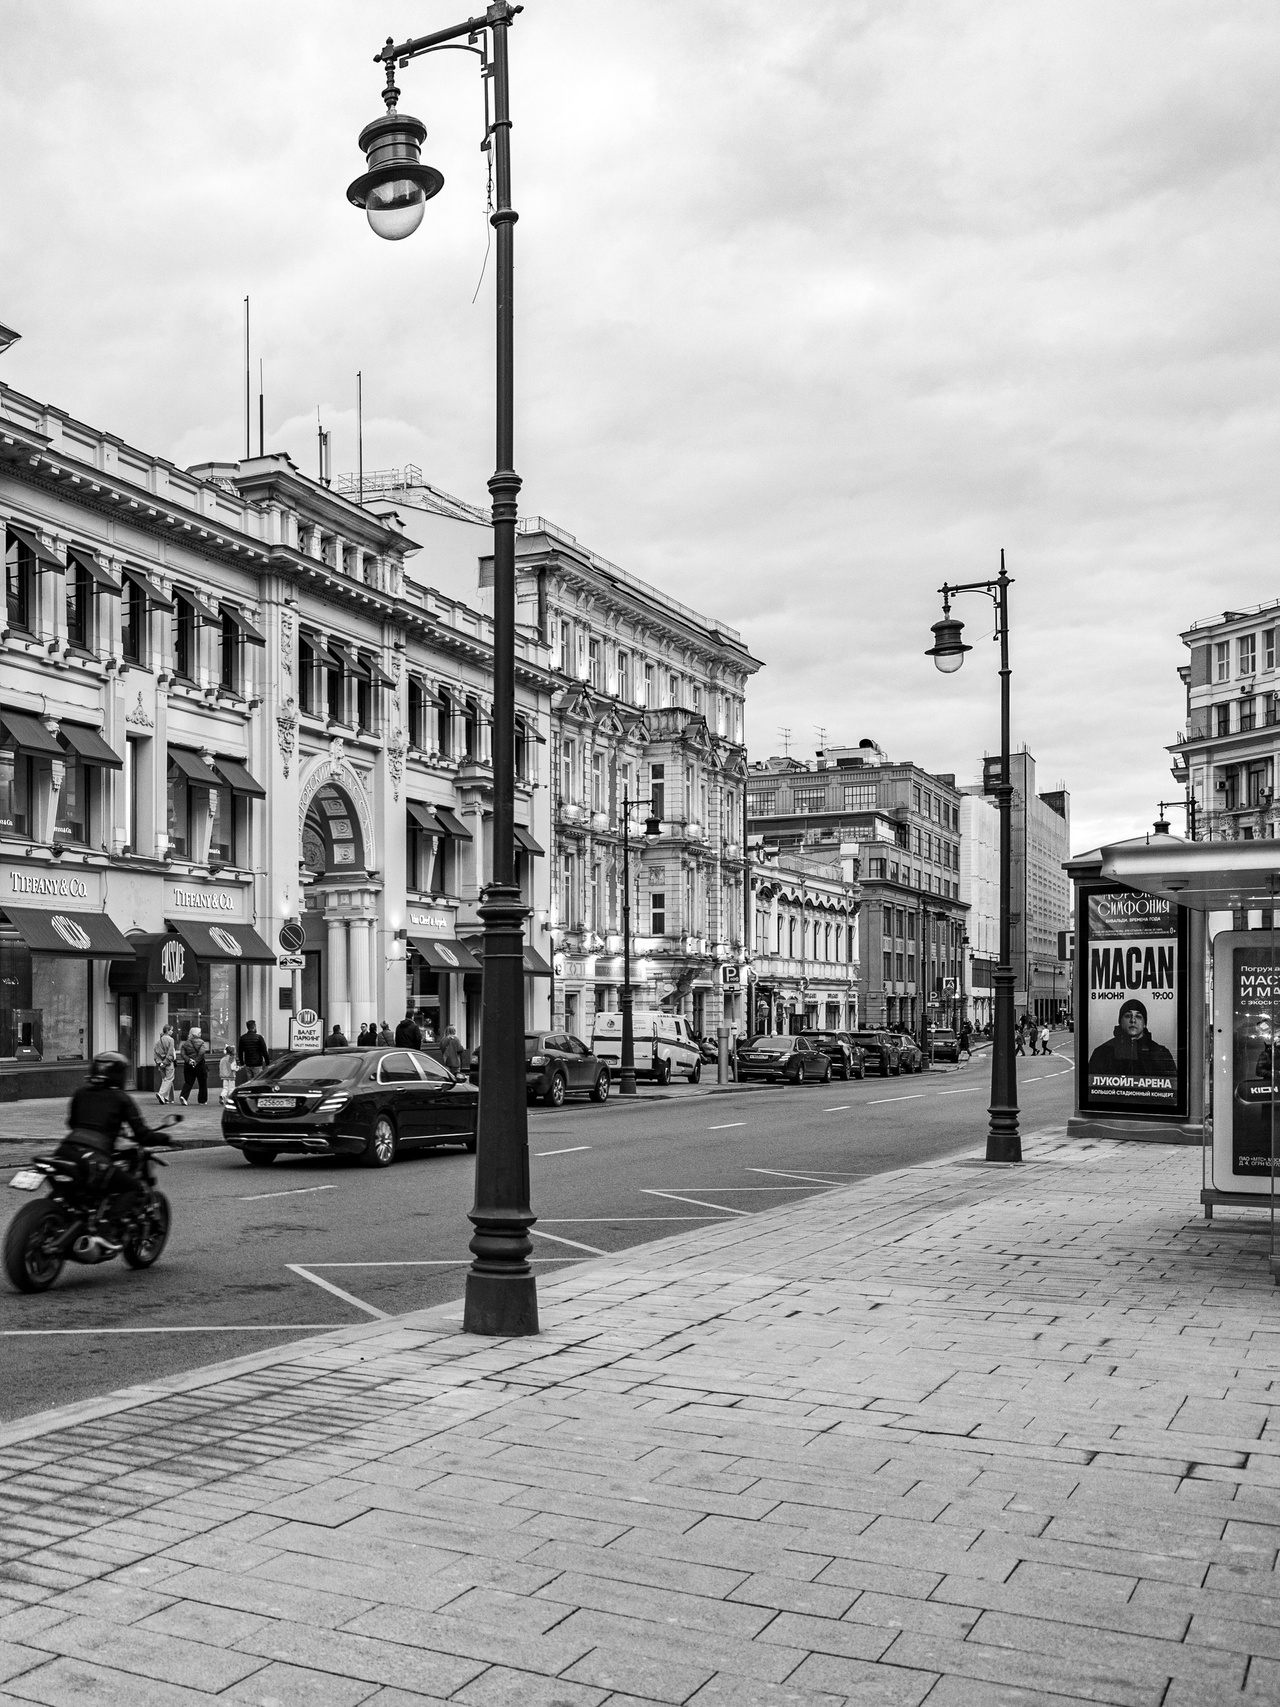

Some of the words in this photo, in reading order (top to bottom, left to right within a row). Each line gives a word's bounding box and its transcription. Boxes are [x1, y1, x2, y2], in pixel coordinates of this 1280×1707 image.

[1097, 899, 1170, 917] СИМФОНИЯ
[726, 967, 737, 982] P
[1091, 946, 1174, 990] MACAN
[1241, 975, 1280, 986] МАС
[1091, 992, 1097, 1000] 8
[1098, 992, 1125, 1000] ИЮНЯ
[1151, 992, 1174, 1000] 19:00
[1241, 987, 1252, 997] И
[1092, 1075, 1172, 1089] ЛУКОЙЛ-АРЕНА
